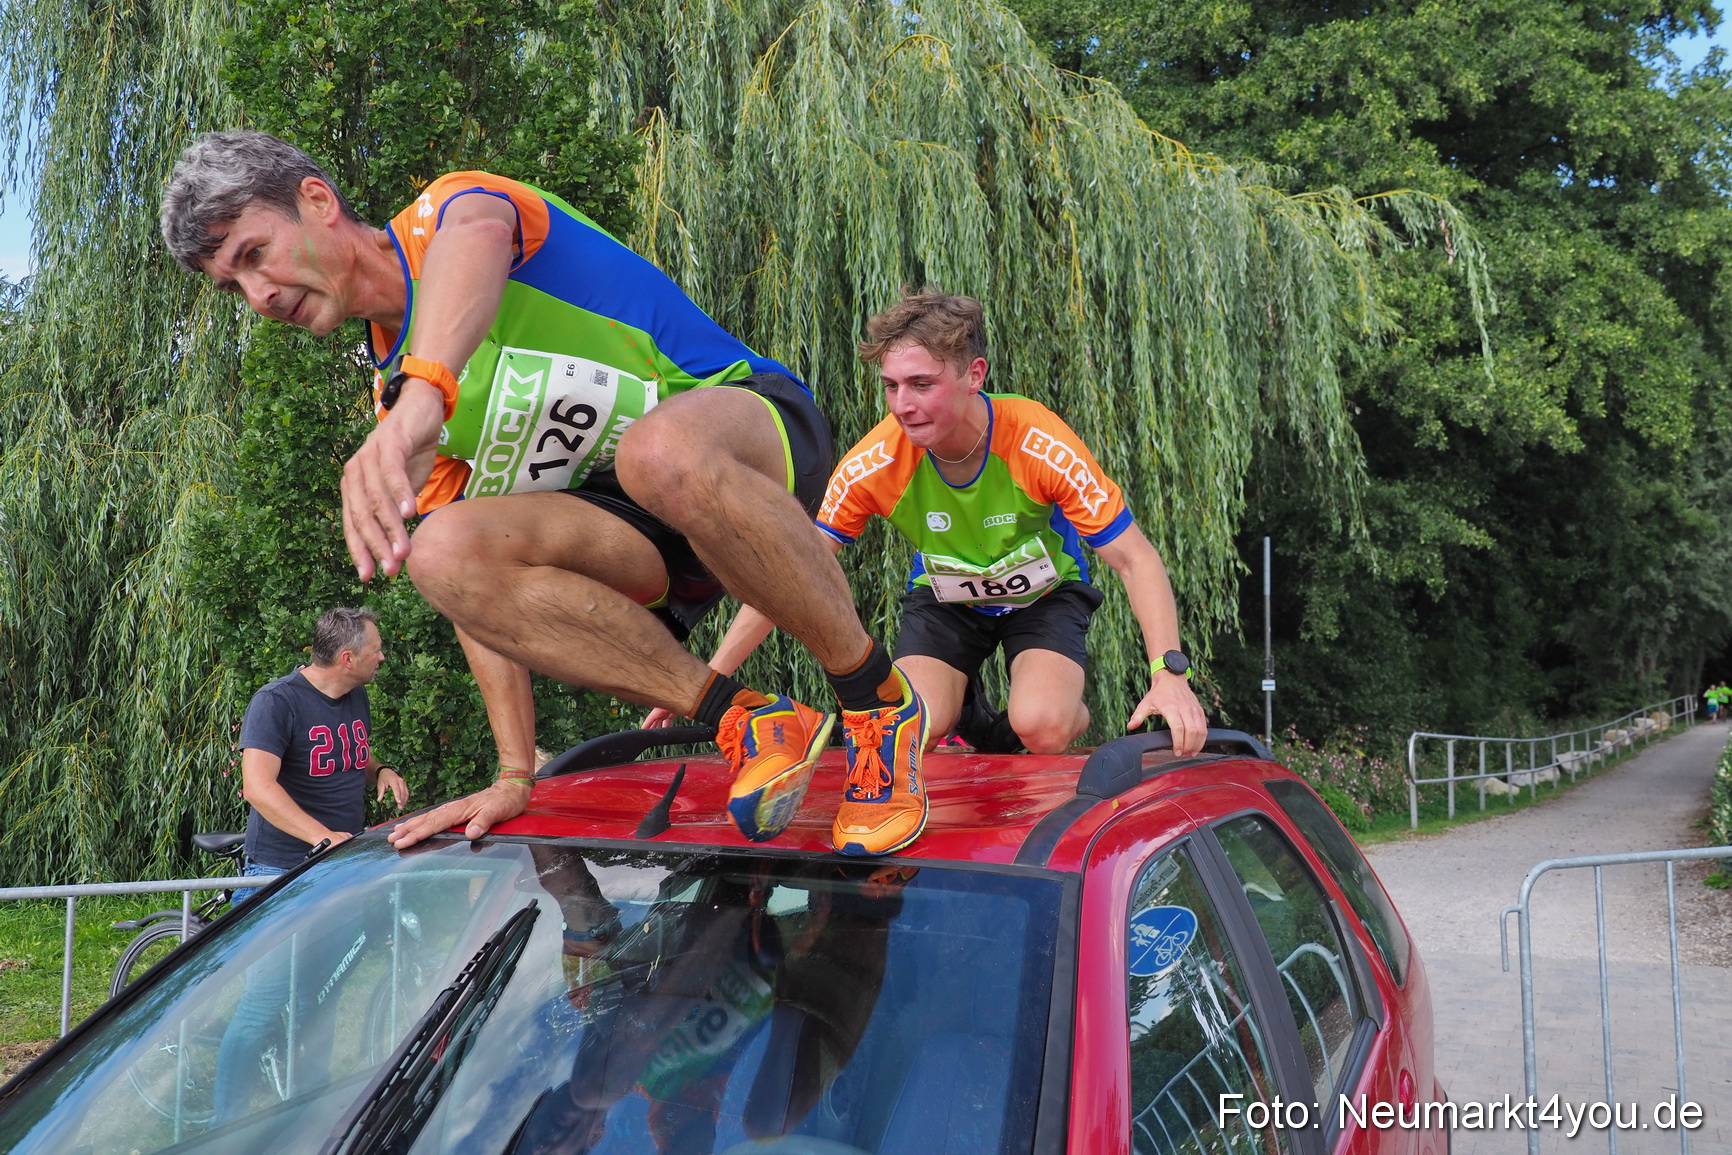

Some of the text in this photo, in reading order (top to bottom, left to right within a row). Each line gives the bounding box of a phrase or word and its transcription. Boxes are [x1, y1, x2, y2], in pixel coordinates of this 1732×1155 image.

[565, 363, 576, 377] E6
[469, 364, 545, 498] BOCK
[528, 399, 598, 481] 126
[1020, 426, 1109, 517] BOCK
[959, 573, 1031, 597] 189
[308, 719, 371, 777] 218
